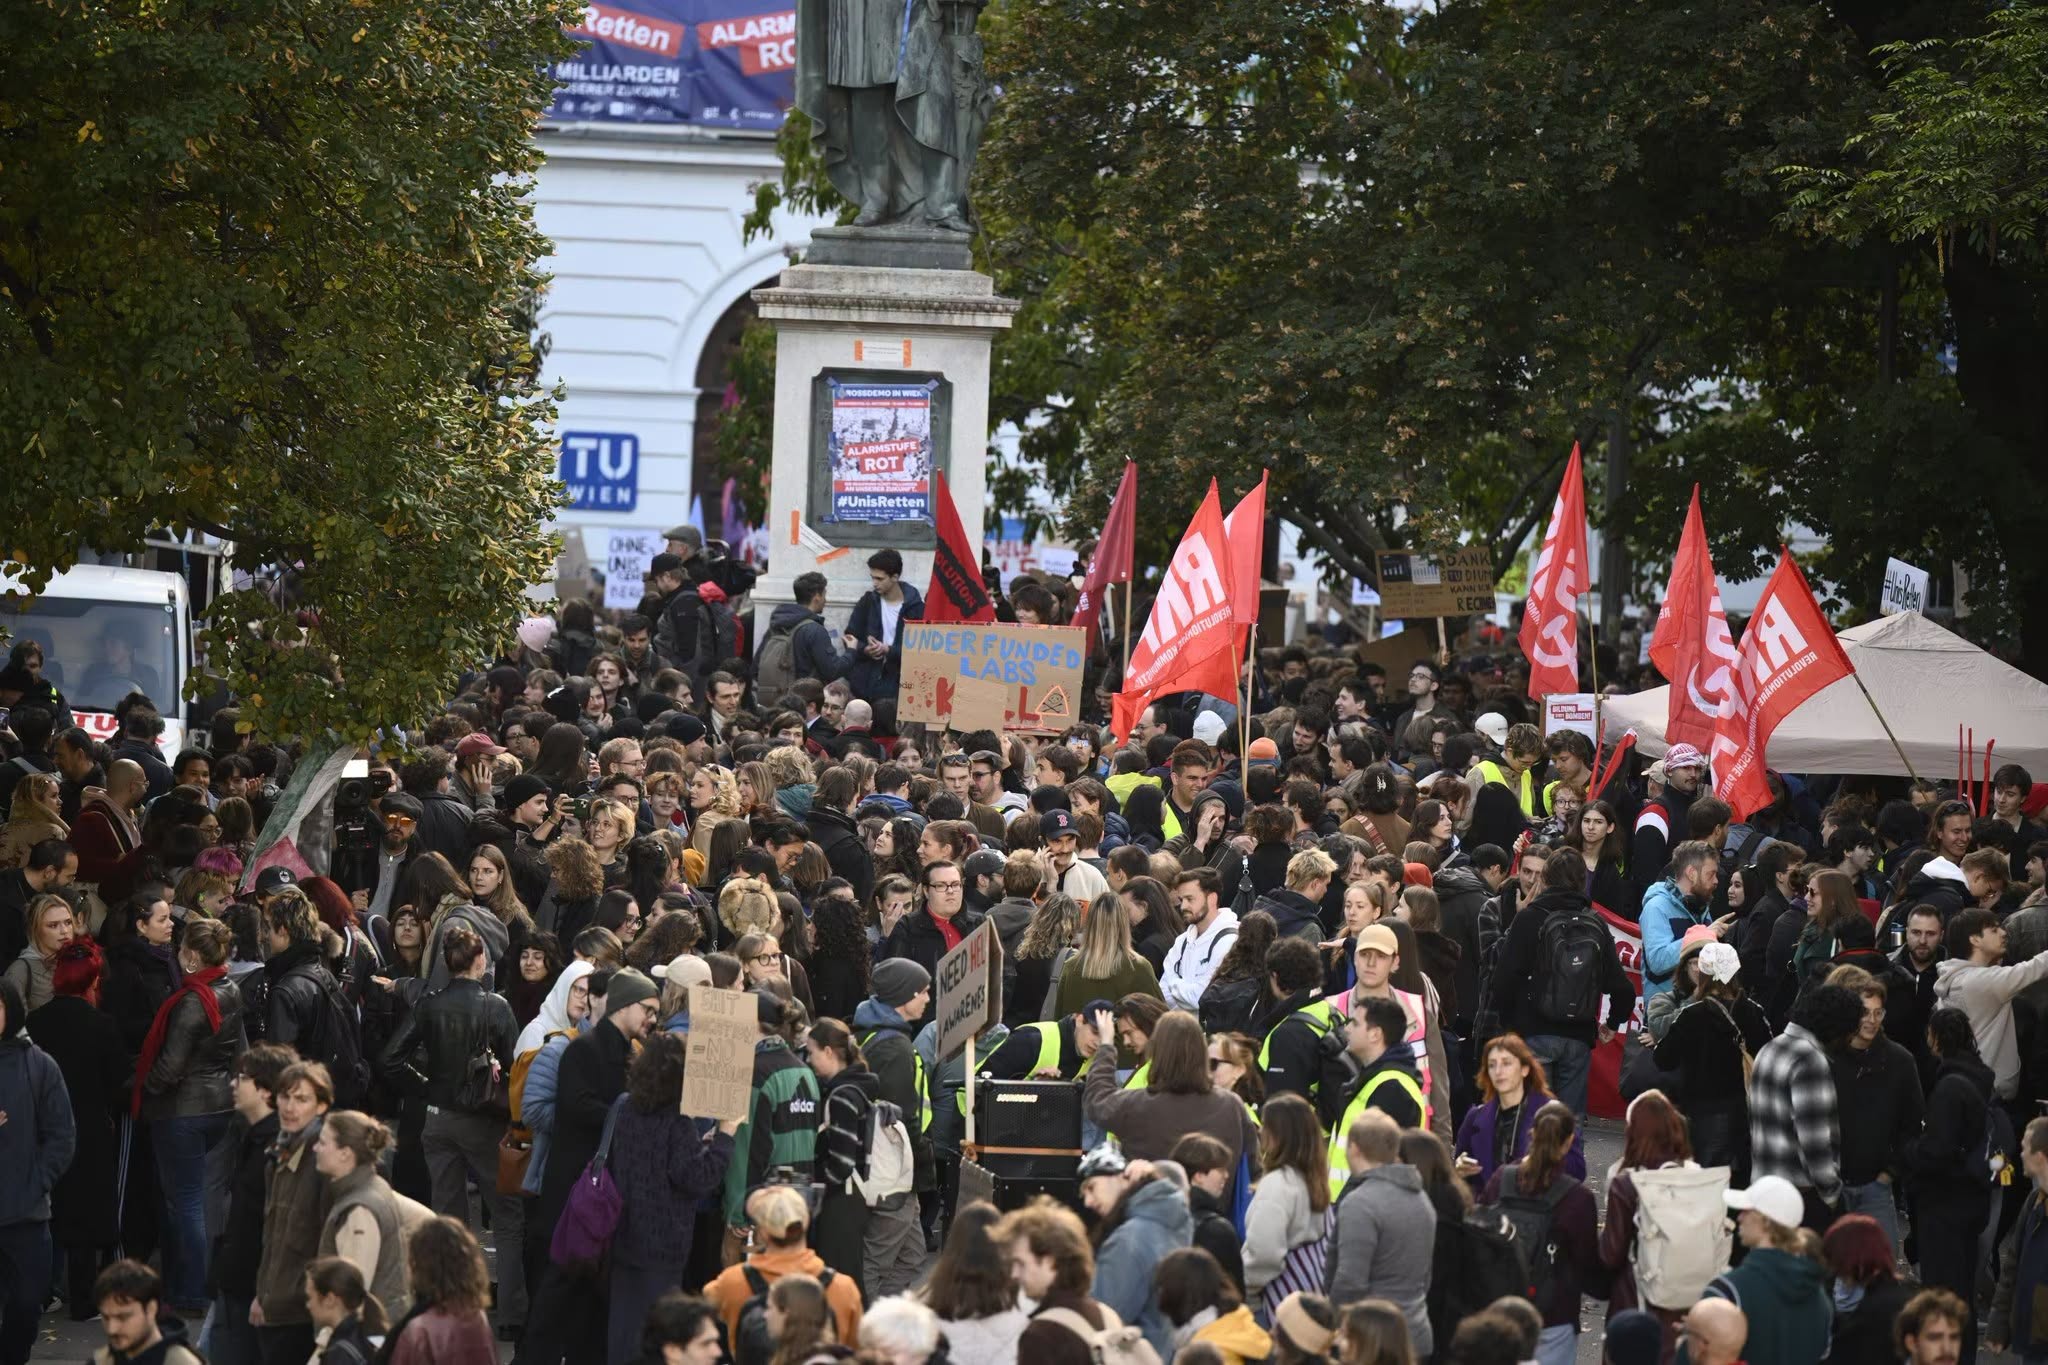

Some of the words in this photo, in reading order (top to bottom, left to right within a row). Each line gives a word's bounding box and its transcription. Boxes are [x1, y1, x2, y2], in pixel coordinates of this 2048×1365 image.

[711, 13, 795, 45] ALARM
[556, 62, 680, 84] MILLIARDEN
[844, 389, 891, 398] ROSSDEMO
[567, 437, 632, 480] TU
[847, 441, 917, 457] ALARMSTUFE
[864, 456, 899, 472] ROT
[568, 484, 632, 505] WIEN
[837, 495, 925, 508] #UnisRetten
[1446, 552, 1490, 567] DANK
[960, 656, 1037, 686] LABS
[940, 948, 968, 995] NEED
